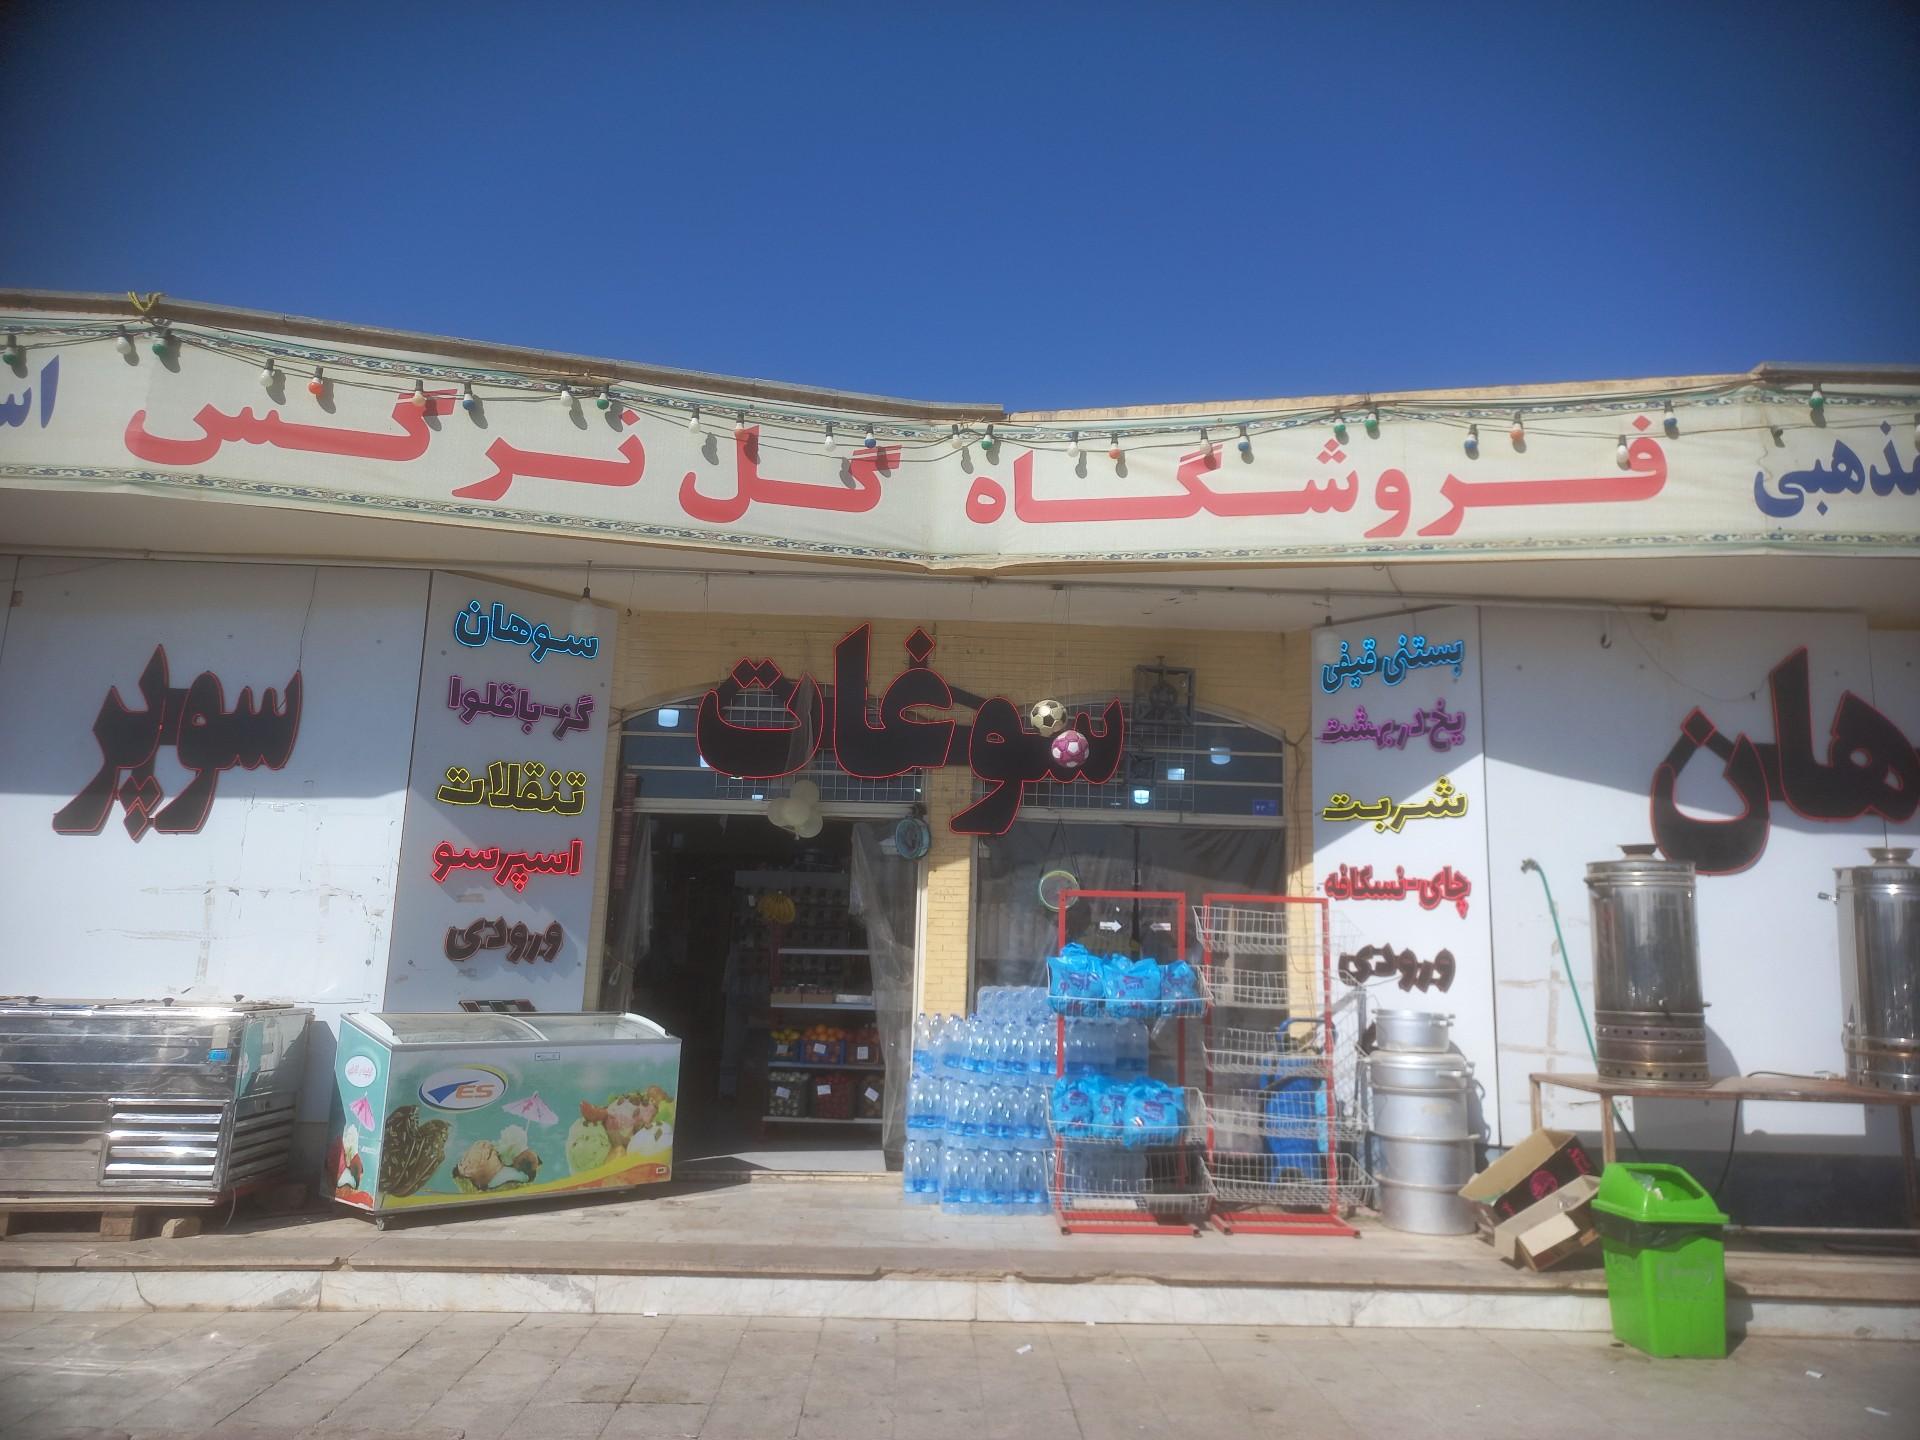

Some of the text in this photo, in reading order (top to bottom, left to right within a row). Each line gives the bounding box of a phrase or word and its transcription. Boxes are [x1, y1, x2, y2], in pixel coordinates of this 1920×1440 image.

[124, 388, 645, 501] نرگس
[679, 425, 902, 523] گل
[1754, 420, 1920, 518] ذهبی
[966, 415, 1668, 538] فروشگاه
[454, 599, 600, 663] سوهان
[1321, 632, 1465, 695] بستنی قیفی
[52, 643, 302, 843] سوپر
[697, 621, 1125, 835] سوغات
[1319, 697, 1466, 753] یخ در بهشت
[436, 760, 587, 816] تنقلات
[1321, 775, 1469, 834] شربت
[431, 838, 584, 894] اسپرسو
[444, 915, 565, 965] ورودی
[1337, 942, 1457, 994] ورودی
